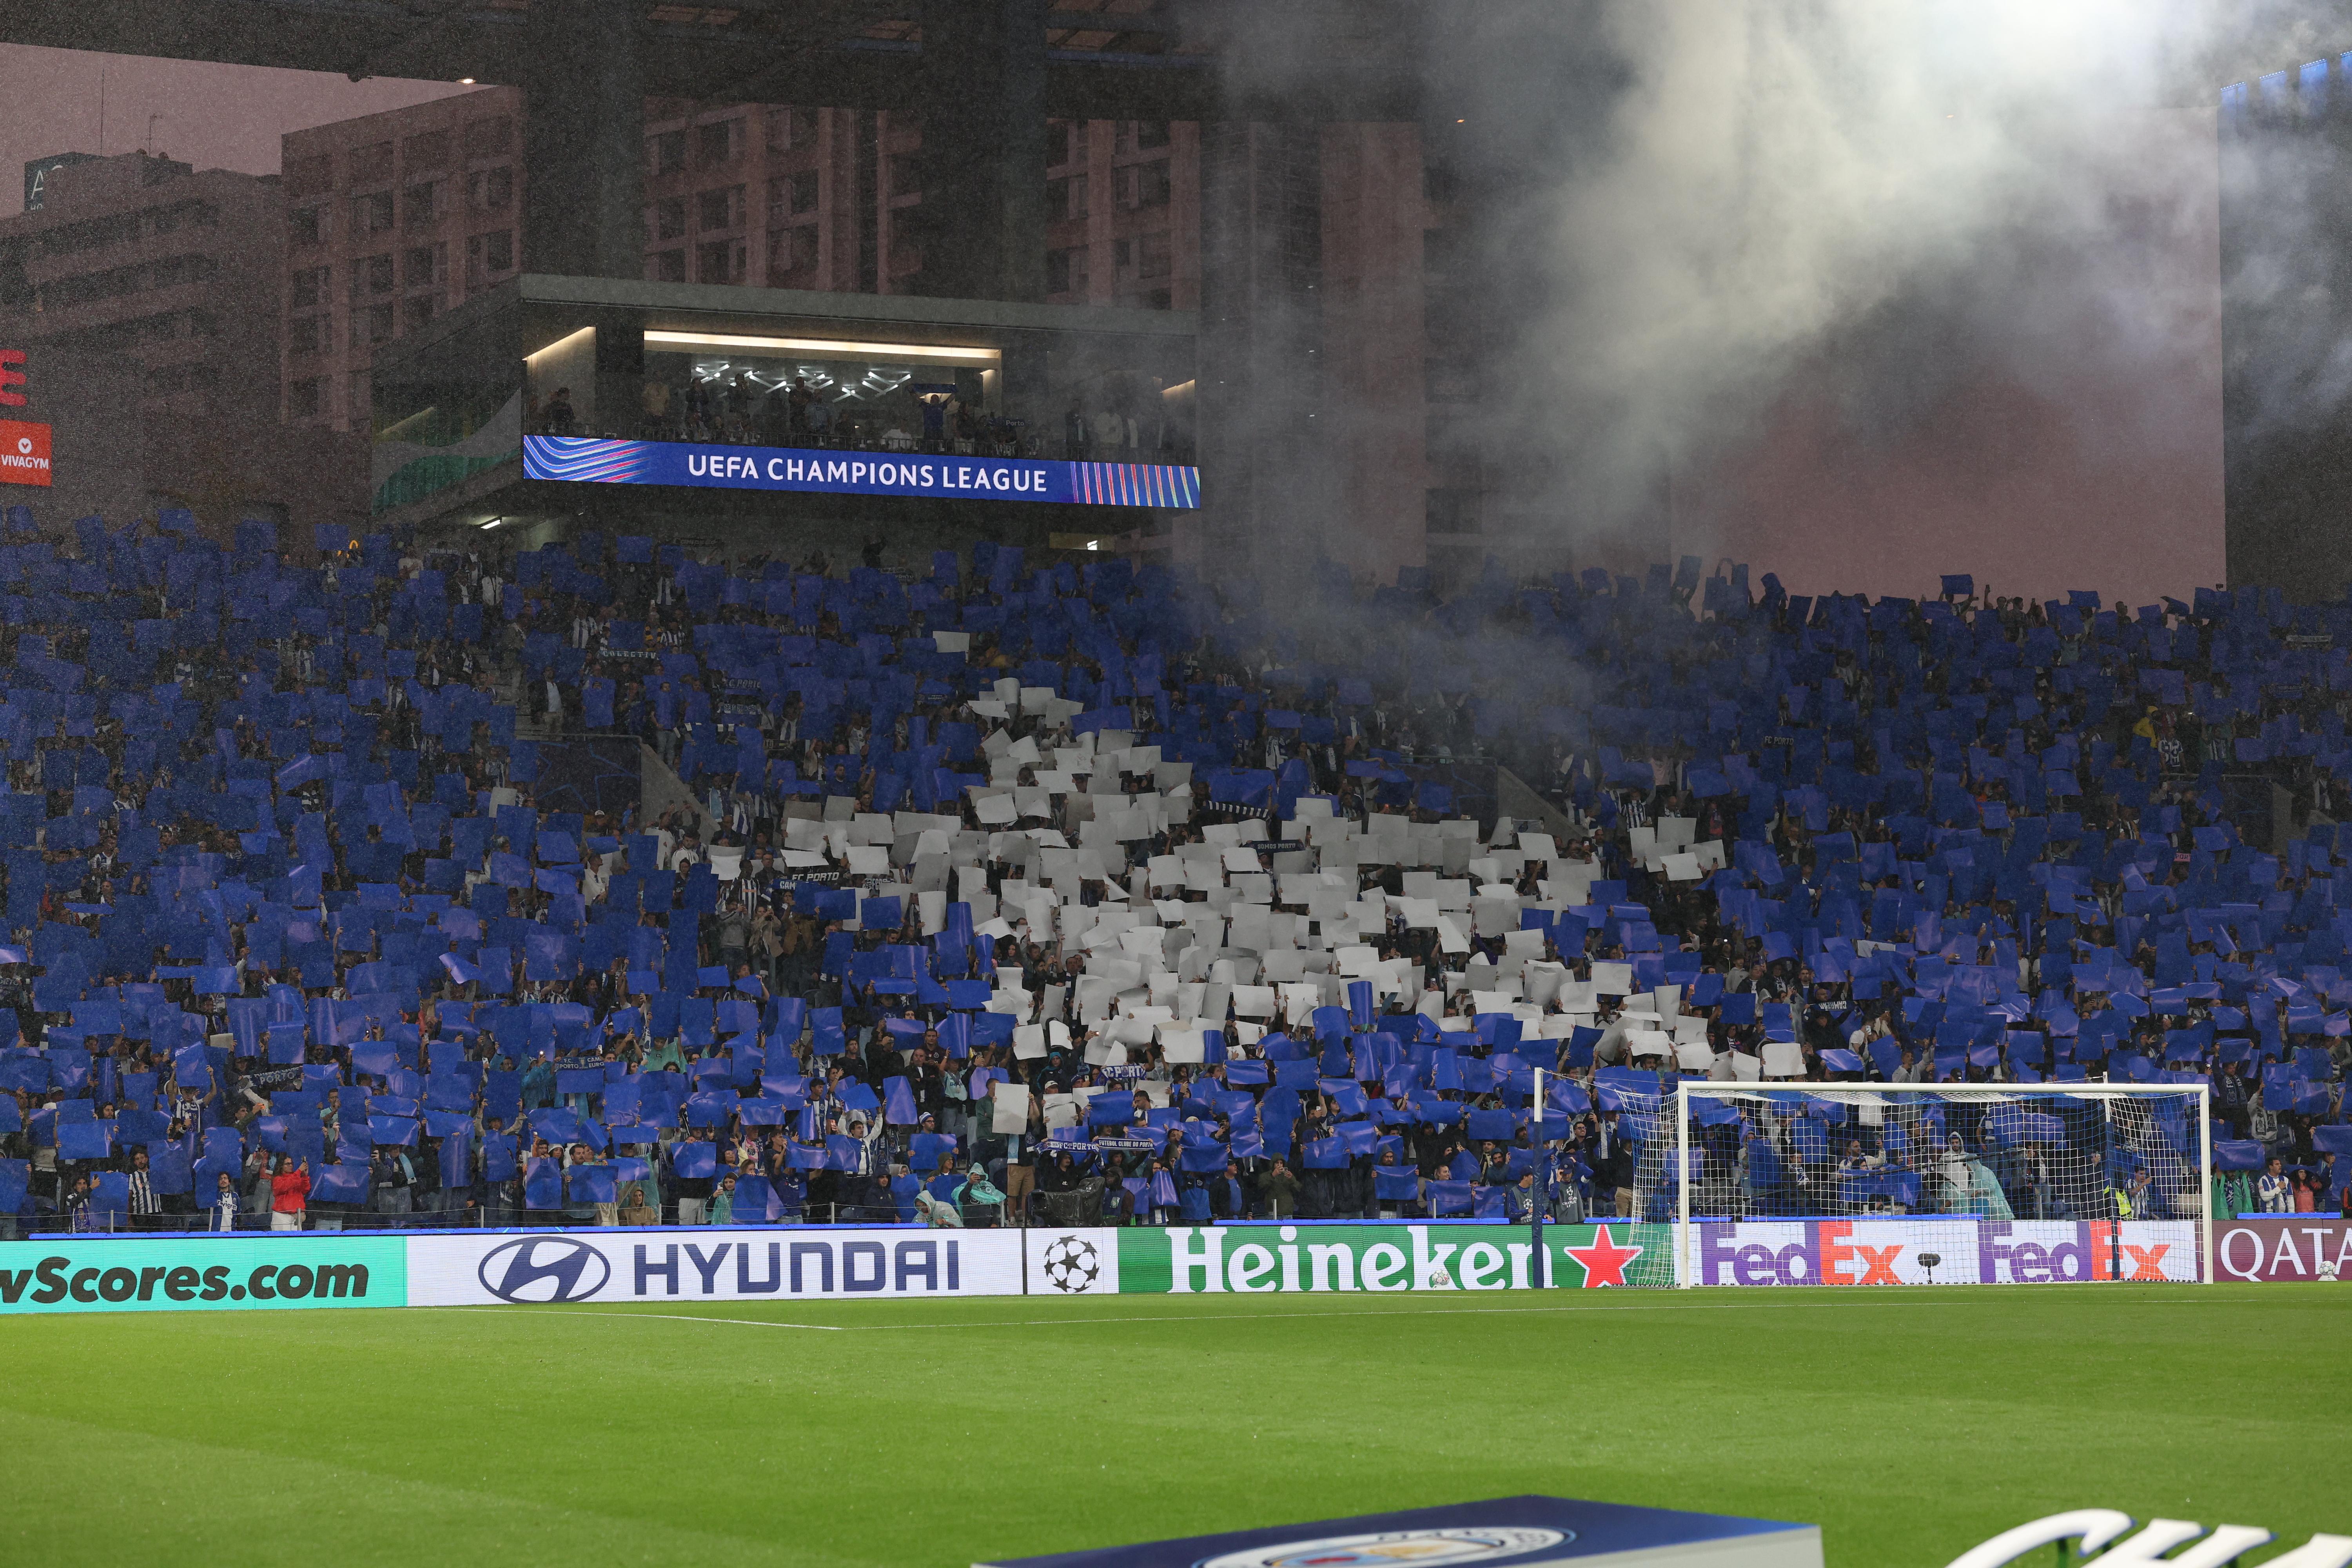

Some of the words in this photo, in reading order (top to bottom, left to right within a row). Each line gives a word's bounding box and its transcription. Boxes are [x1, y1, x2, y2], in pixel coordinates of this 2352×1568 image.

[1, 455, 49, 470] VIVAGYM
[689, 455, 759, 478] UEFA
[768, 458, 933, 486] CHAMPIONS
[943, 466, 1046, 491] LEAGUE
[1774, 737, 1794, 745] PORTO
[807, 872, 839, 881] PORTO
[634, 1241, 959, 1295] HYUNDAI
[1165, 1225, 1559, 1293] Heineken
[1700, 1221, 1904, 1286] FedEx
[1979, 1220, 2170, 1283] FedEx
